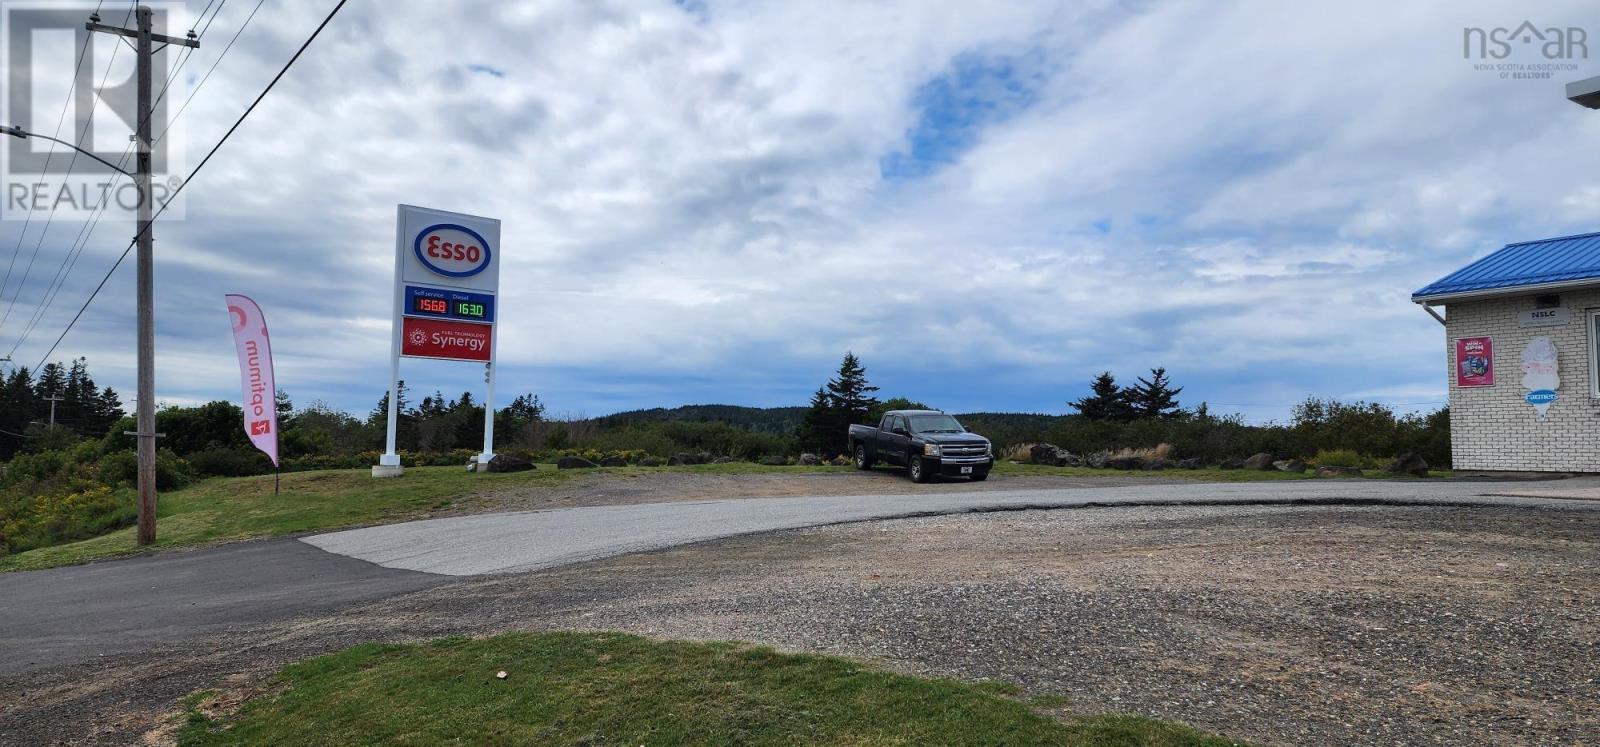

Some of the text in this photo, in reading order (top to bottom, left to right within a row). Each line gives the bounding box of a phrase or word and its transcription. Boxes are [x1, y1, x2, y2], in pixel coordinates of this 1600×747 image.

[414, 289, 424, 297] Self
[1531, 310, 1556, 318] NSLC
[432, 332, 486, 351] Synergy
